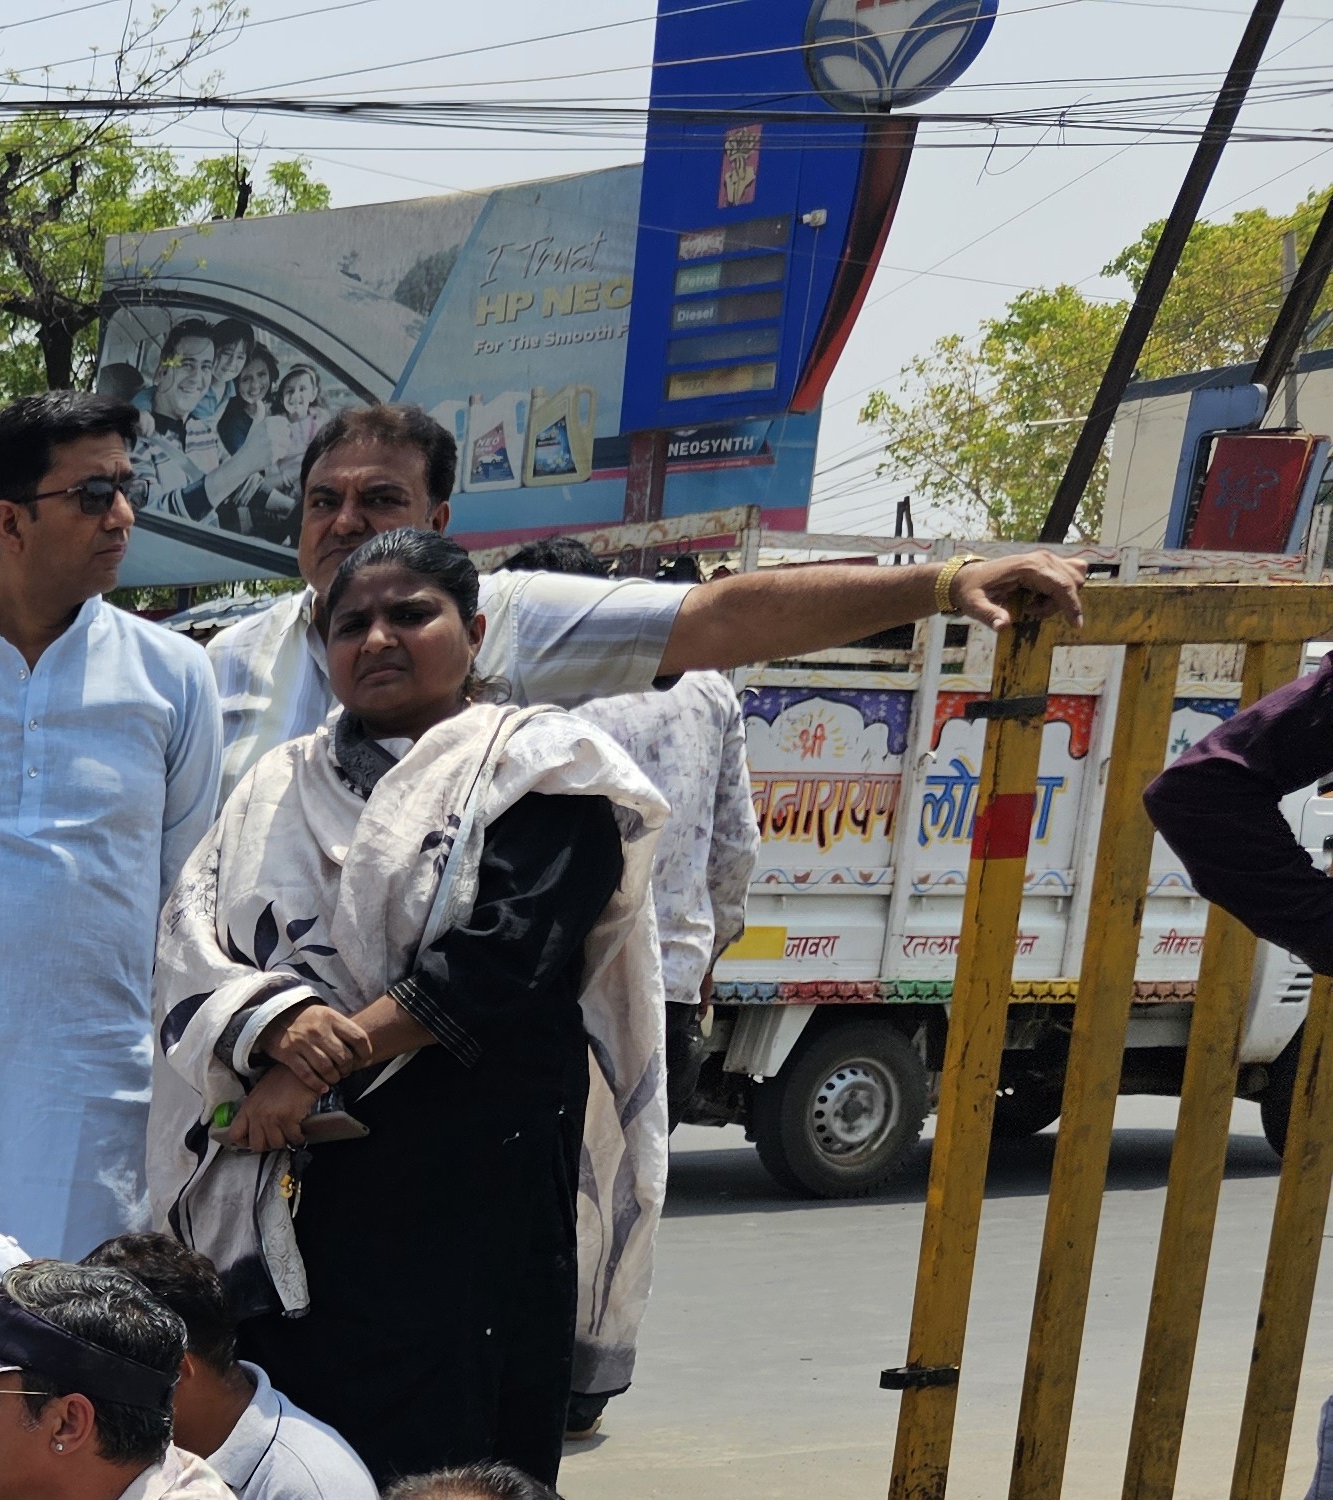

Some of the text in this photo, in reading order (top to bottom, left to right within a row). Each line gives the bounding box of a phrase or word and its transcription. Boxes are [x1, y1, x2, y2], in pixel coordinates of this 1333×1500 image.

[517, 230, 608, 280] Trust
[678, 272, 719, 287] Petrol
[475, 274, 633, 327] HP NEO
[676, 306, 715, 323] Diesel
[474, 339, 504, 356] For
[508, 334, 541, 351] The
[543, 323, 614, 348] Smooth
[476, 436, 500, 448] NEO
[667, 436, 754, 457] NEOSYNTH
[792, 722, 827, 761] श्री
[785, 935, 840, 958] जावरा
[902, 935, 961, 958] रतला
